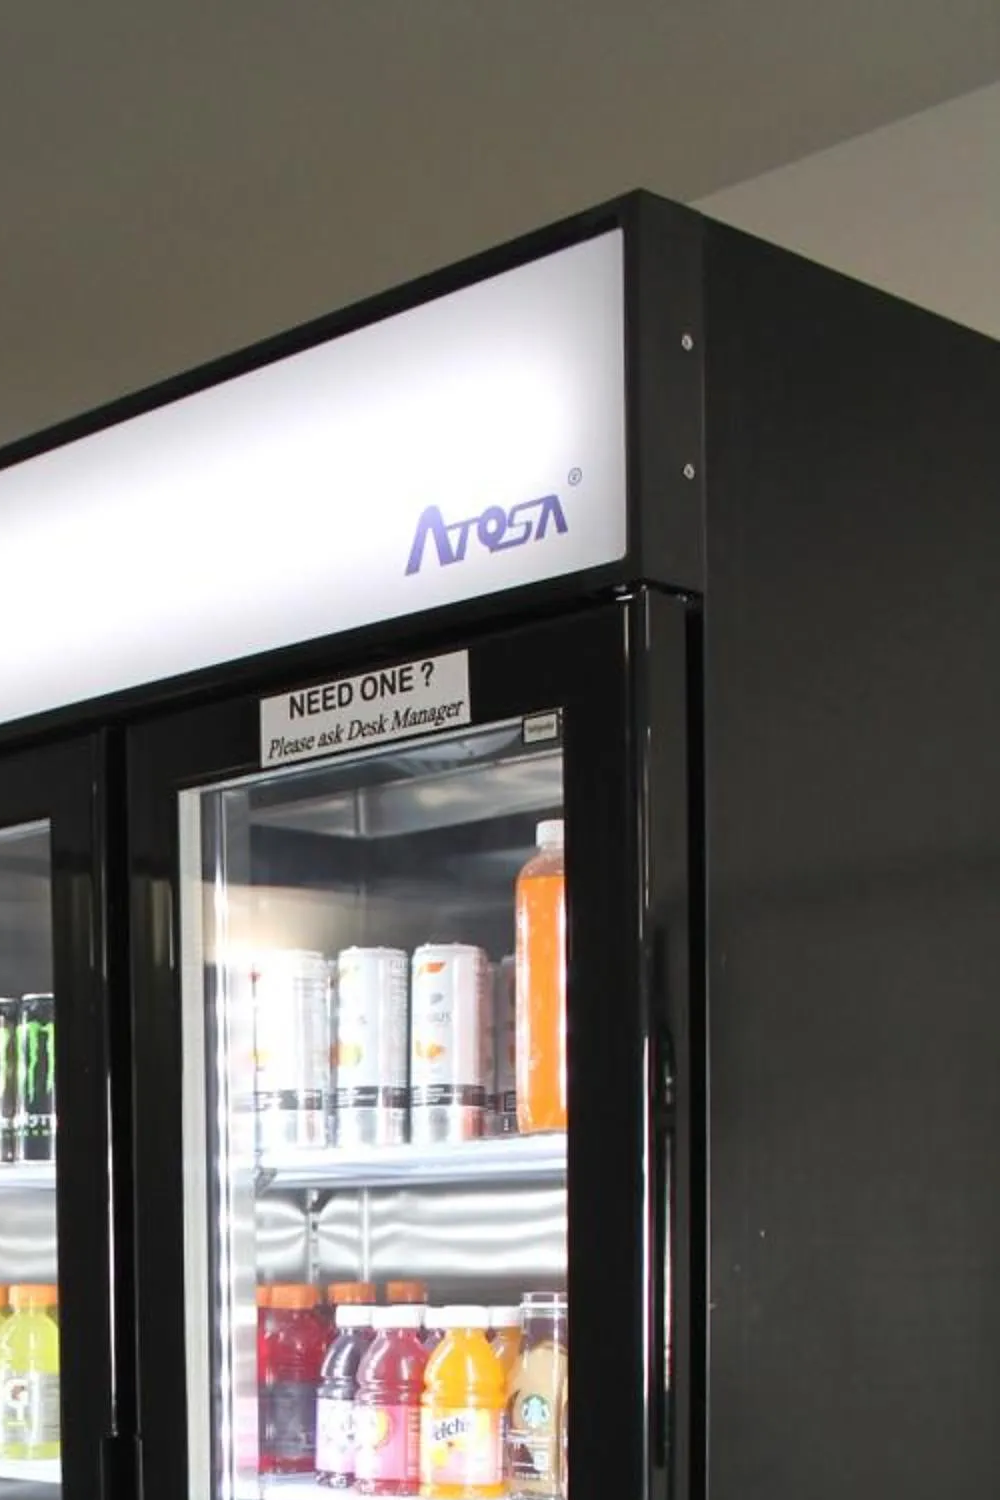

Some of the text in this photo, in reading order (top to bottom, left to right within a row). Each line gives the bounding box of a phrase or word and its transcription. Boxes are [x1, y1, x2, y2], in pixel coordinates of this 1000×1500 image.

[288, 661, 435, 720] NEED ONE ?
[267, 700, 465, 761] Please ask Desk Manager
